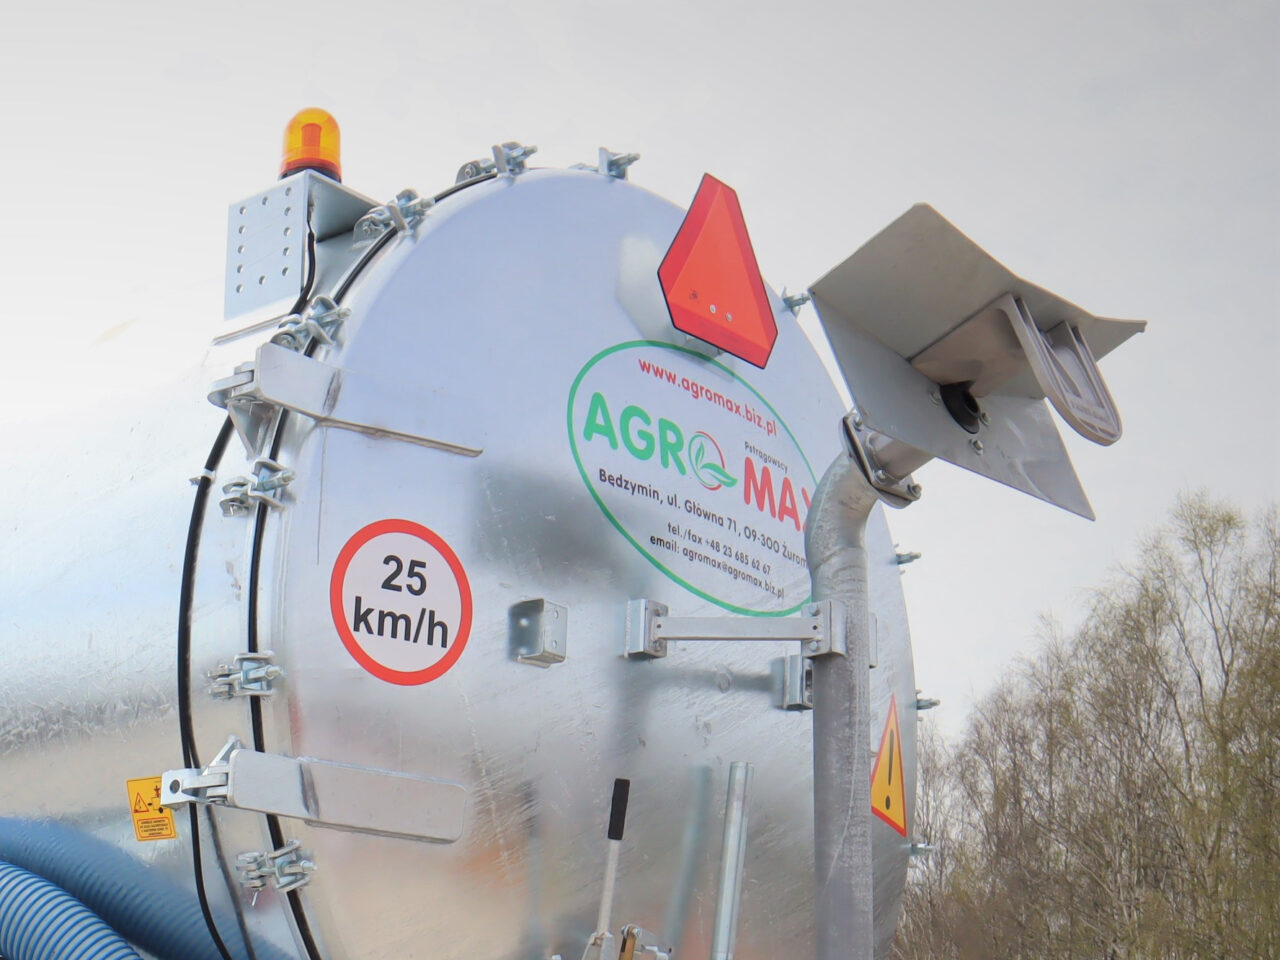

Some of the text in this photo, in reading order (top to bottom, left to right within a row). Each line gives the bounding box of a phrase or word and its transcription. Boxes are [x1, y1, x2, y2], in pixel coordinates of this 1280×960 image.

[638, 358, 777, 437] www.agromax.biz.pl
[599, 468, 663, 505] Będzymin,
[667, 494, 681, 509] ul.
[684, 499, 724, 527] Główna
[744, 525, 780, 553] 09-300
[381, 554, 427, 596] 25
[650, 535, 784, 599] email: agromax@agromax.biz.pl
[667, 522, 771, 576] tel./fax +48 23 685 62 67
[353, 596, 448, 648] km/h
